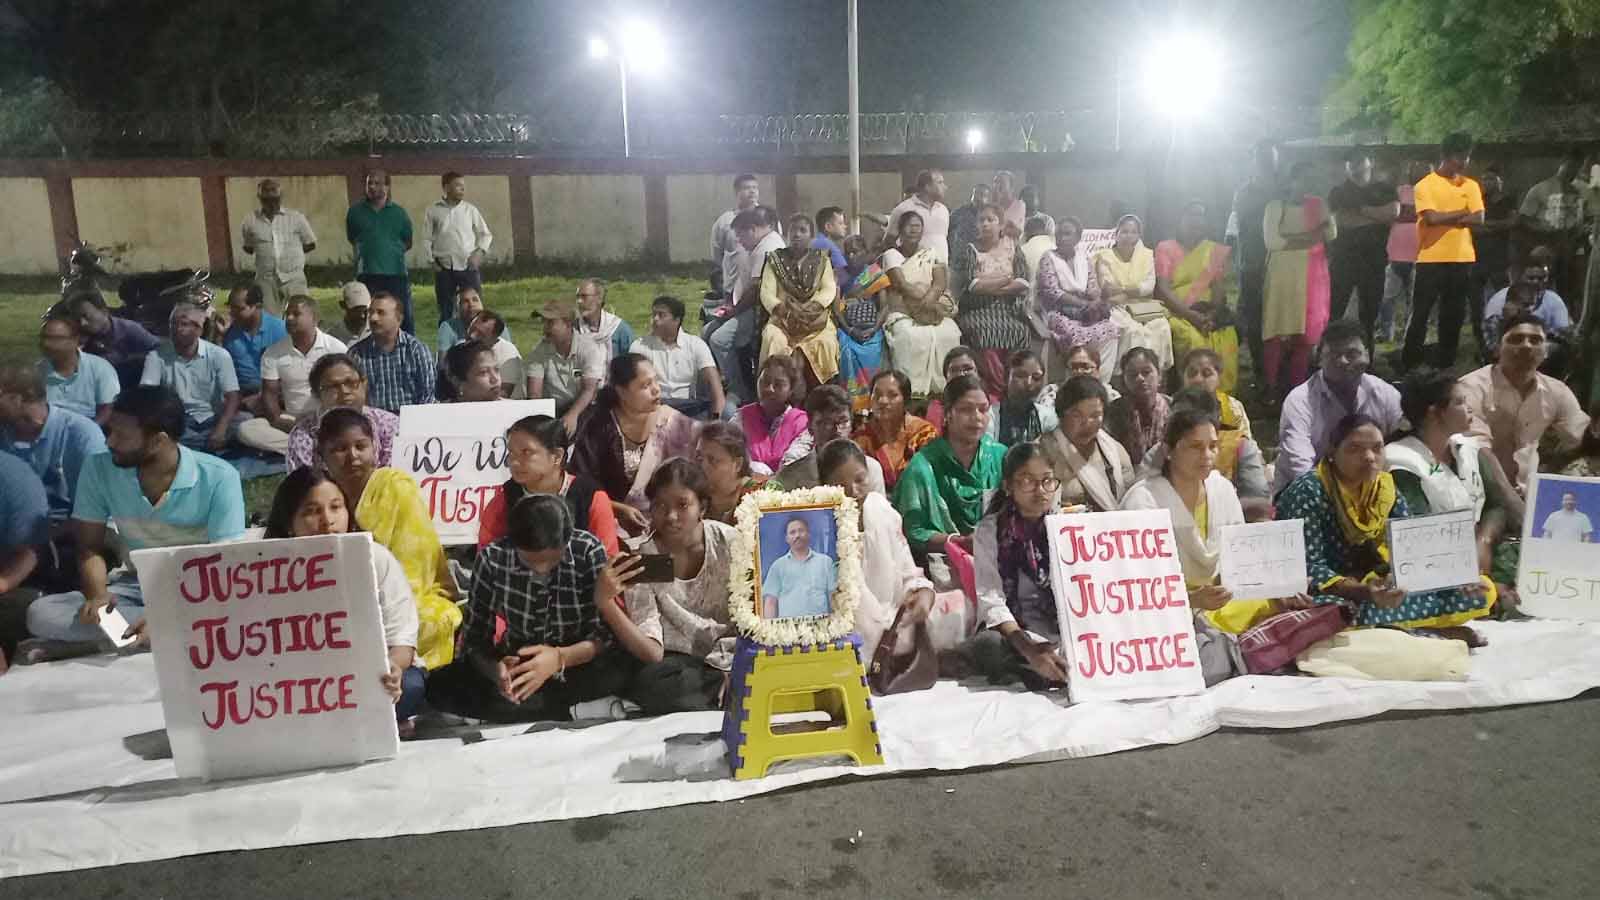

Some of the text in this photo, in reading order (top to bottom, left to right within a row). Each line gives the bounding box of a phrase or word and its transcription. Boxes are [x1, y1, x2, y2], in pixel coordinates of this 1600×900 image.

[404, 437, 462, 474] We
[1060, 525, 1172, 565] JUSTICE
[180, 552, 336, 603] JUSTICE
[1067, 574, 1185, 618] JUSTICE
[189, 611, 351, 669] JUSTICE
[1077, 632, 1195, 678] JUSTICE
[200, 674, 357, 730] JUSTICE
